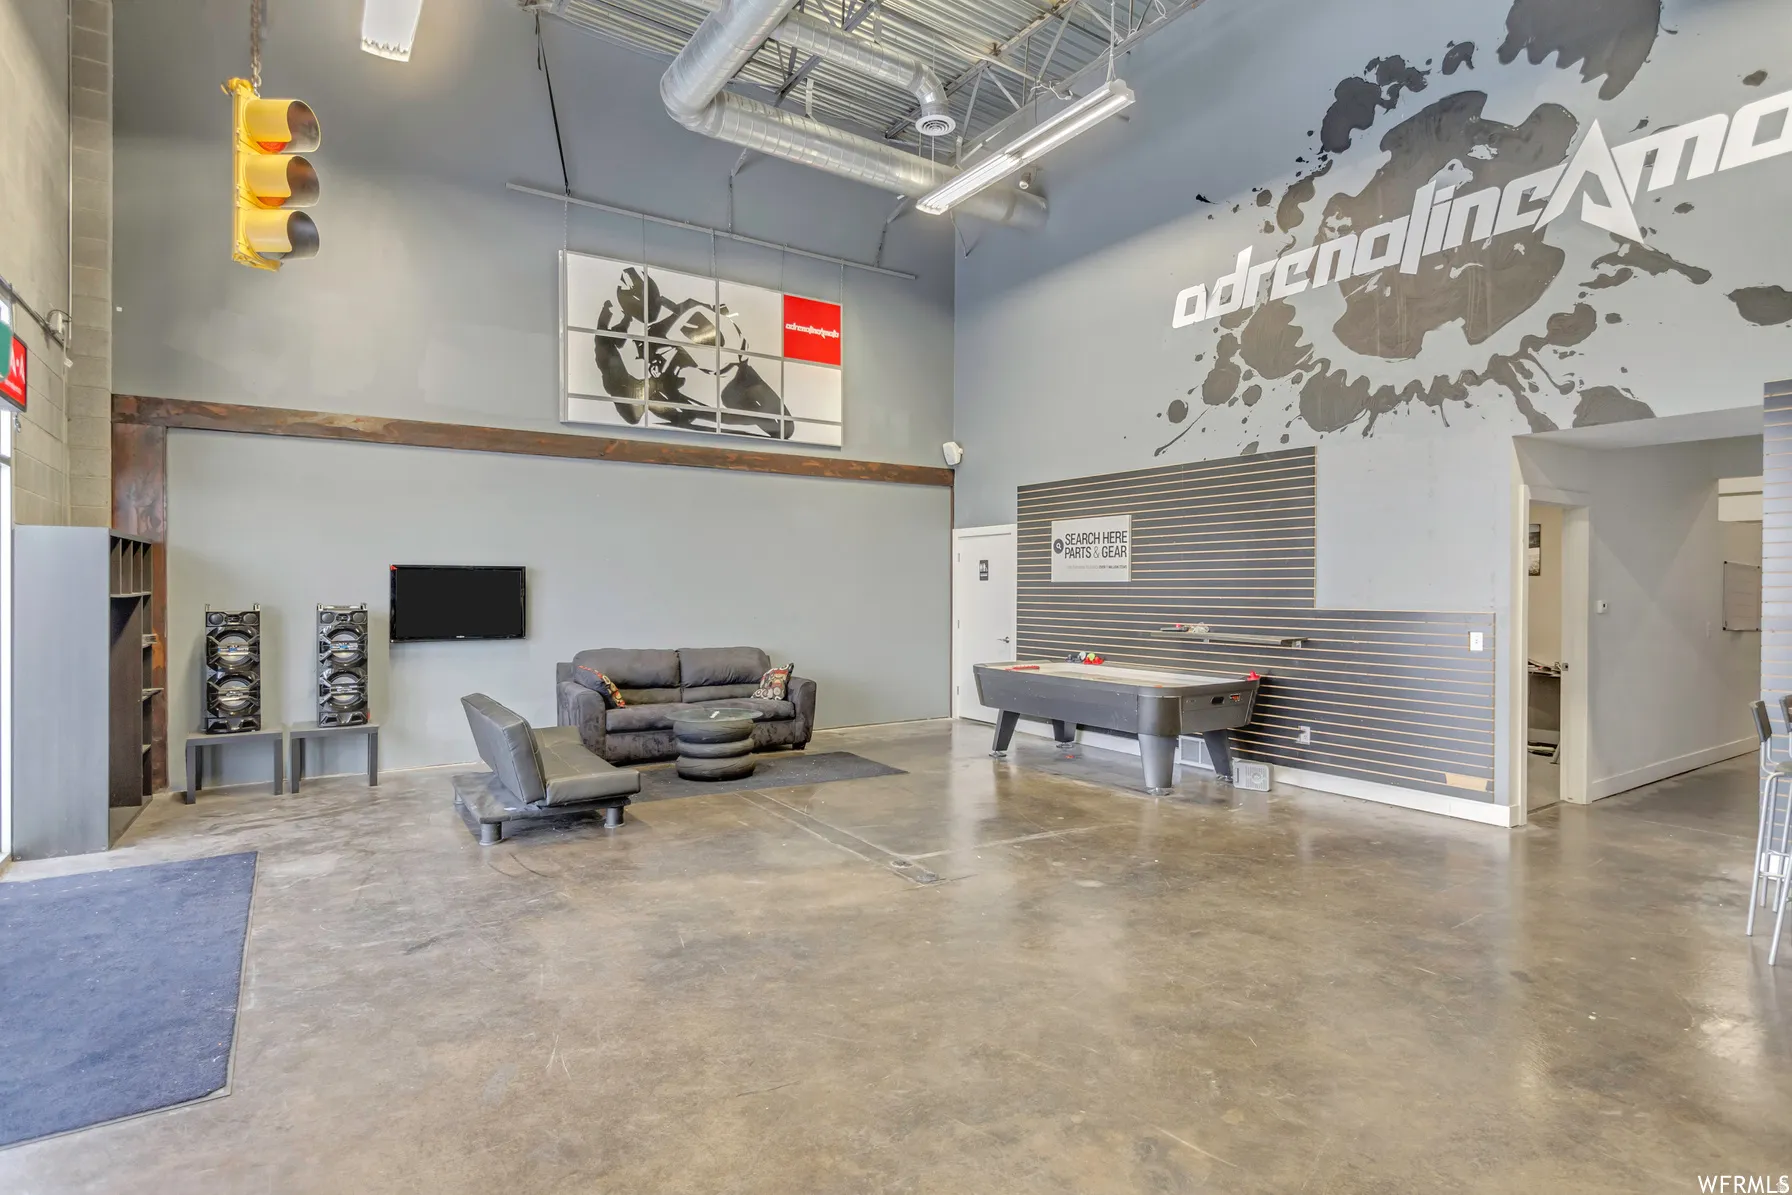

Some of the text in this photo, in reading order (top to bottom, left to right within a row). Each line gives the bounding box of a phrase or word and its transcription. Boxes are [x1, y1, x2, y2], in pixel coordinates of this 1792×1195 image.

[1065, 531, 1127, 545] SEARCH HERE
[1064, 545, 1127, 559] PARTS & GEAR
